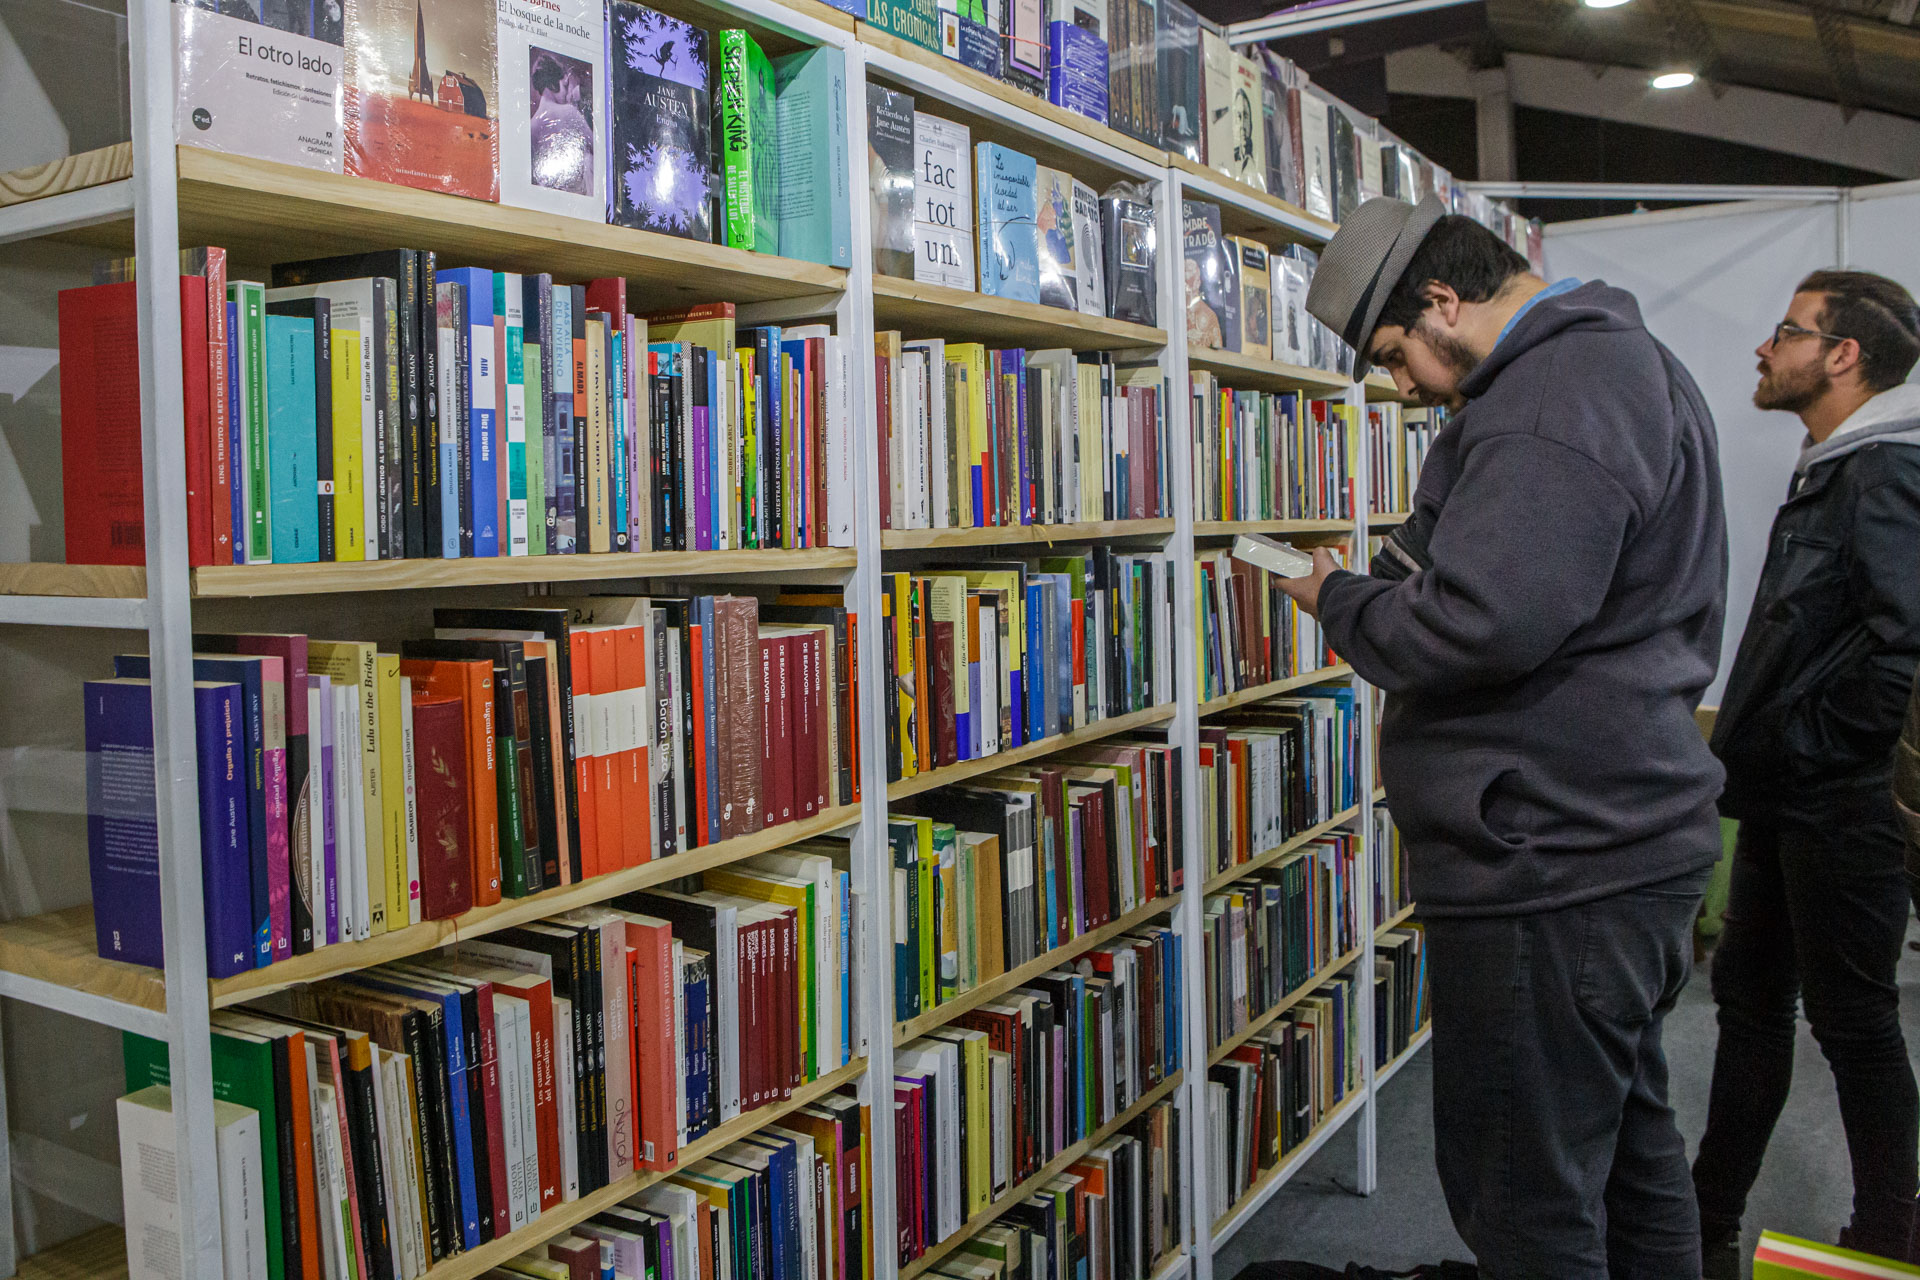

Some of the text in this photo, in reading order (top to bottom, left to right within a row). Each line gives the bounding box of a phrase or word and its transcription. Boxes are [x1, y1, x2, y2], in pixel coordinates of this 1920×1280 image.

[510, 5, 542, 24] bosque
[544, 15, 555, 27] de
[556, 18, 564, 31] la
[565, 24, 590, 40] noche
[866, 0, 888, 27] LAS
[892, 7, 939, 50] CRÓNICAS
[238, 35, 333, 76] El otro lado
[303, 86, 332, 98] onfesiones
[643, 92, 689, 117] AUSTEN
[656, 85, 677, 98] JANE
[724, 44, 748, 152] STEPHEN KING
[201, 116, 211, 124] ed.
[876, 105, 911, 123] Recuerdos de
[876, 117, 911, 135] Jane Austen
[298, 135, 333, 148] ANAGRAMA
[919, 134, 938, 146] Charles
[923, 150, 956, 189] fac
[993, 170, 1031, 188] insoportable
[728, 164, 738, 222] DE SALEM'S LOT
[738, 170, 748, 214] EL MISTERIO
[1074, 185, 1099, 209] ERNESTO
[926, 197, 956, 228] tot
[1005, 205, 1019, 213] ser
[1074, 199, 1098, 224] SABATO
[1183, 217, 1208, 234] MBRE
[924, 240, 961, 268] um
[426, 260, 434, 306] ALFAGUARA
[322, 312, 330, 360] Poema de Mio Cid
[362, 336, 370, 360] Roldán
[556, 300, 564, 378] DEL INVIERNO
[216, 348, 224, 380] TERROR
[364, 361, 370, 370] de
[388, 310, 398, 402] PANZA BURRO
[480, 358, 488, 378] AIRA
[408, 354, 416, 390] ACIMAN
[576, 360, 584, 394] ALMADA
[216, 382, 224, 397] DEL
[216, 400, 224, 414] REY
[218, 415, 224, 426] AL
[378, 410, 386, 439] HUMANO
[410, 425, 418, 451] nombre
[430, 422, 438, 448] Enigma
[480, 414, 490, 462] Diez novelas
[380, 455, 386, 464] AL
[412, 452, 418, 460] tu
[218, 462, 226, 484] KING.
[380, 500, 388, 516] ABE
[380, 516, 388, 533] KOBO
[764, 648, 770, 660] DE
[780, 645, 785, 656] DE
[803, 642, 809, 654] DE
[814, 640, 820, 650] DE
[658, 632, 666, 692] Christian Ferrer
[272, 692, 280, 740] JANE AUSTEN
[364, 650, 376, 753] Lulu on the Bridge
[566, 686, 574, 733] BAZTERRICA
[252, 694, 260, 741] JANE AUSTEN
[224, 698, 232, 780] Orgullo y prejuicio
[484, 702, 494, 770] Eugenia Grandet
[658, 698, 670, 772] Barón Biza
[254, 748, 262, 790] Persuasión
[404, 728, 412, 780] miguel barnet
[272, 746, 282, 818] Orgullo y prejuicio
[228, 797, 238, 848] Jane Austen
[662, 788, 670, 831] inmoralista
[300, 797, 308, 854] sentimiento
[300, 862, 308, 902] Sensatez
[616, 986, 624, 1038] COMPLETOS
[534, 1032, 542, 1060] jinetes
[542, 1038, 552, 1102] del Apocalipsis
[536, 1090, 544, 1106] Los
[613, 1098, 628, 1168] BOLAÑO
